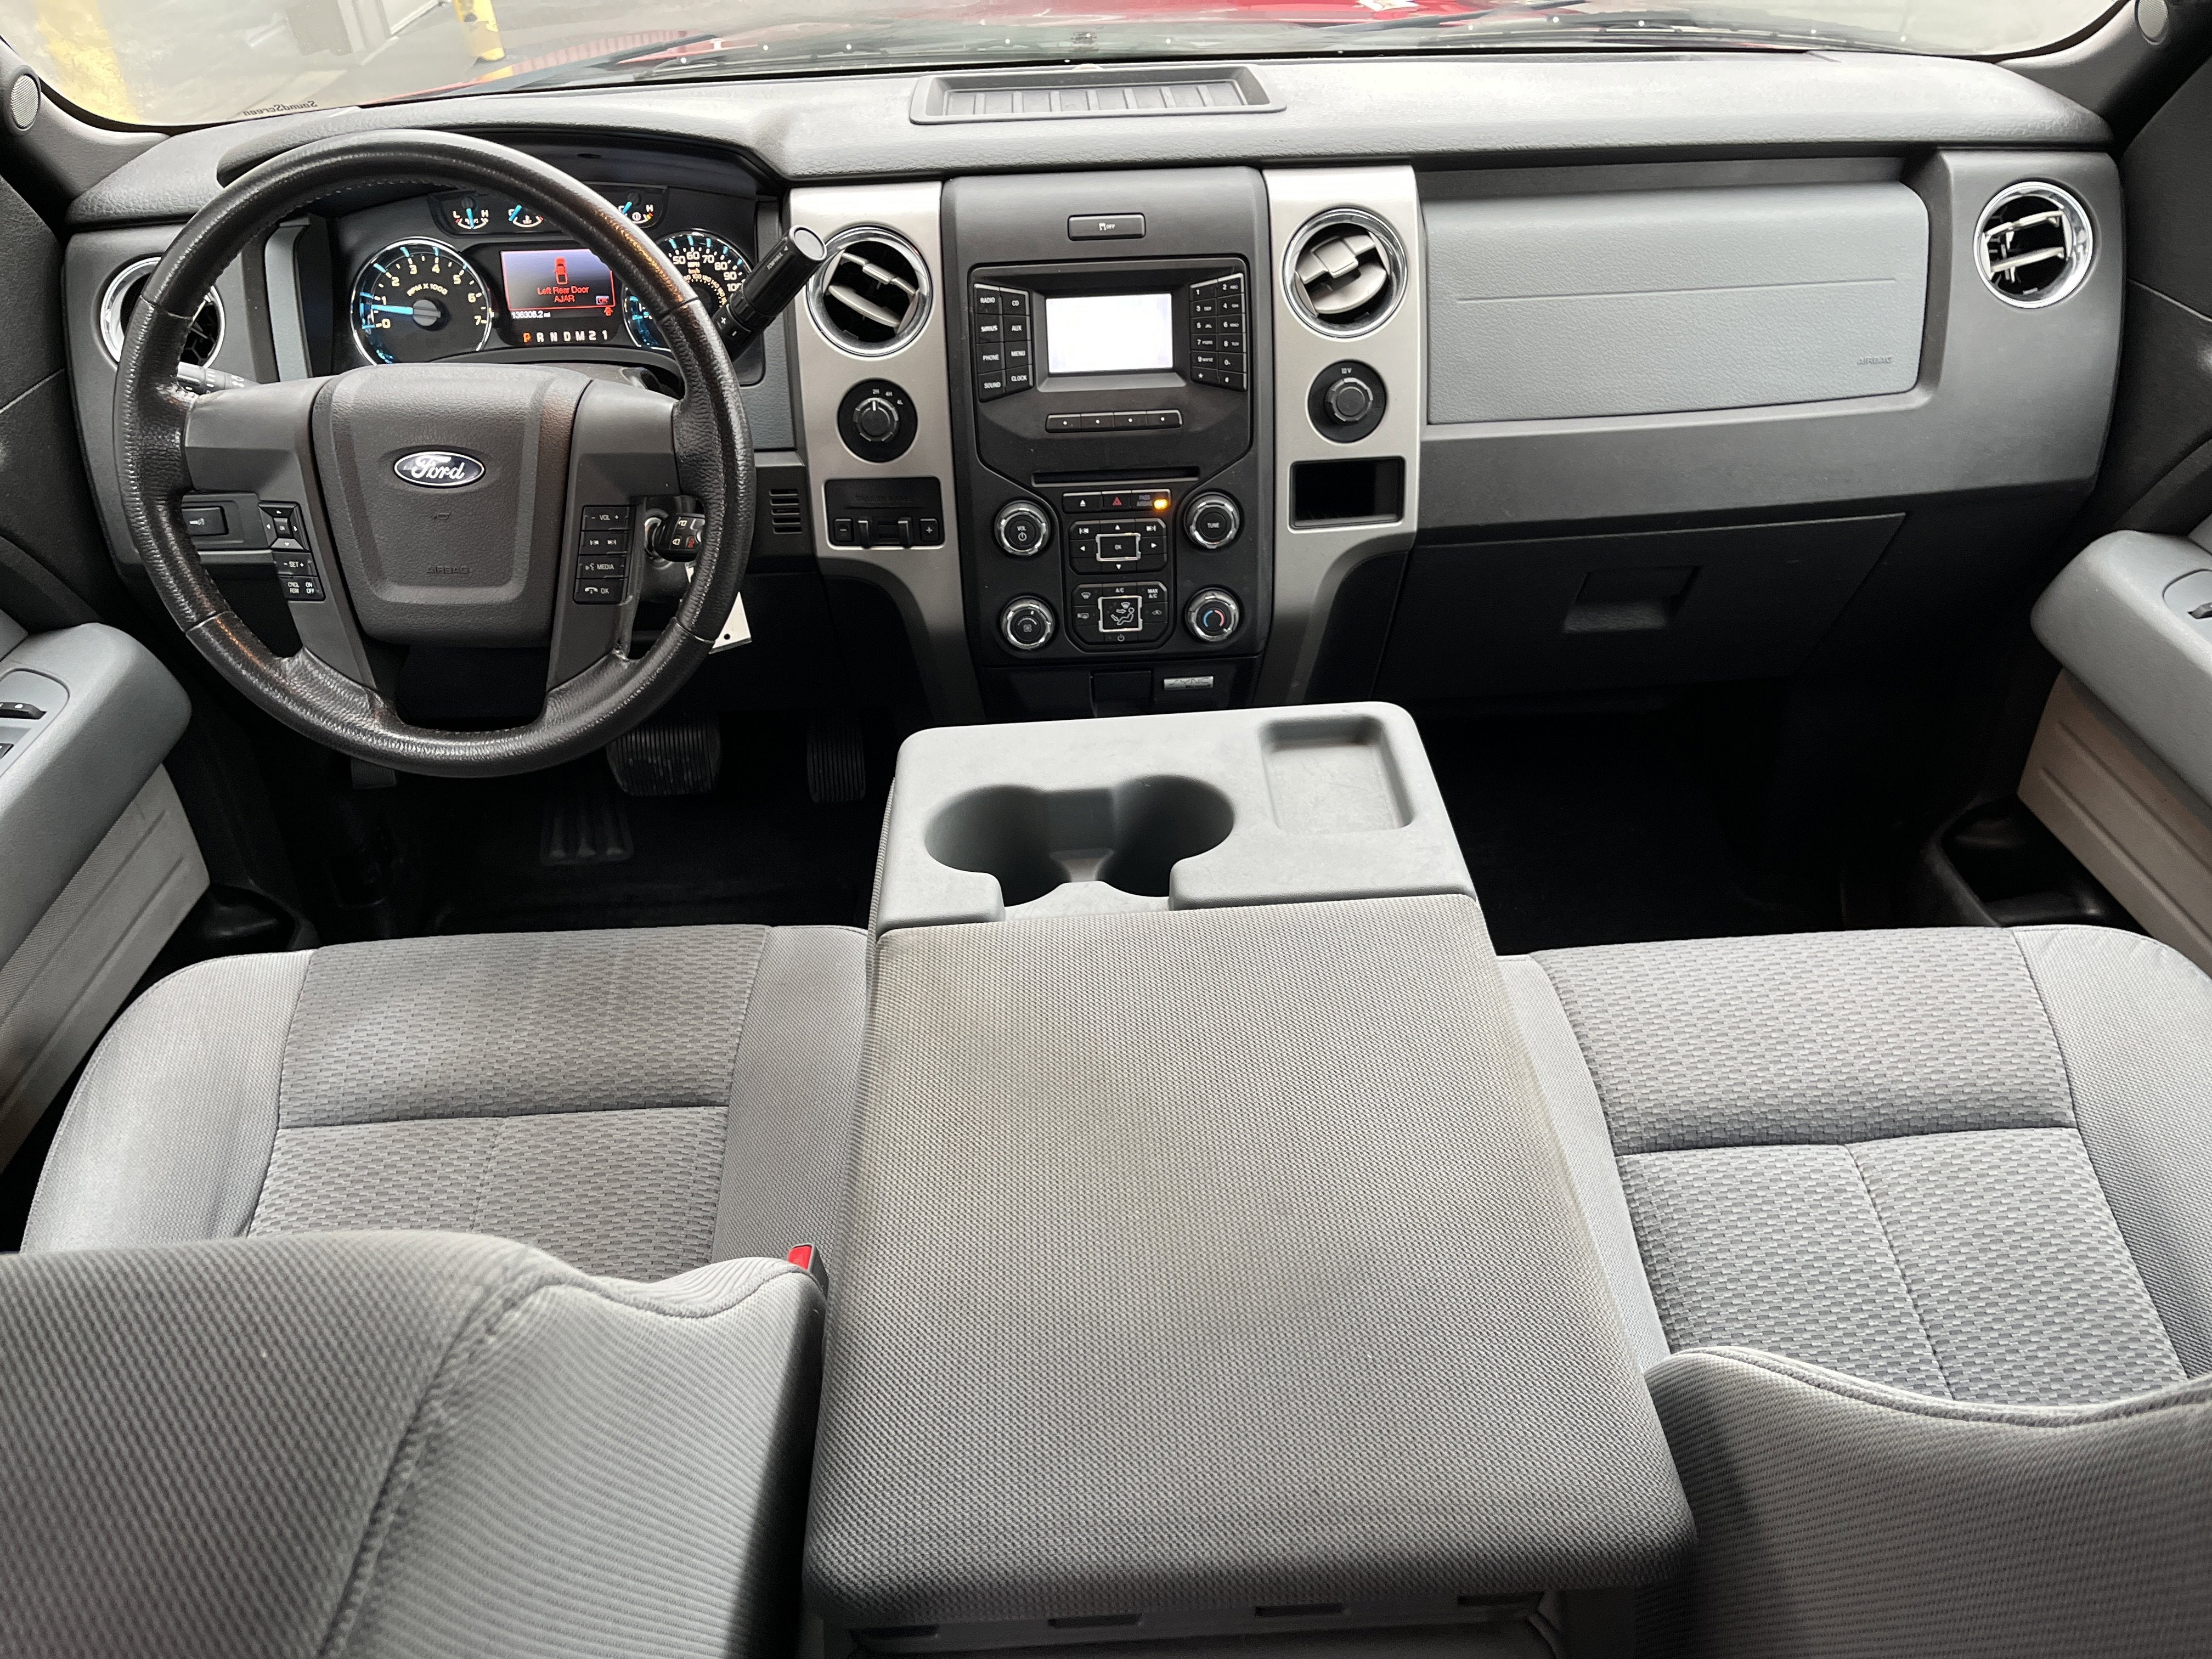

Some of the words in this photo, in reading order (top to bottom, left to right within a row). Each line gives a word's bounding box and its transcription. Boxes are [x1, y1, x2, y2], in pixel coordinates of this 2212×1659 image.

[673, 256, 686, 265] 50
[686, 251, 700, 260] 60
[702, 255, 715, 263] 70
[409, 264, 417, 274] 3
[432, 264, 440, 273] 4
[714, 262, 727, 270] 80
[392, 276, 400, 286] 2
[453, 274, 461, 284] 5
[723, 272, 737, 280] 90
[430, 283, 448, 295] 1000
[537, 286, 552, 295] Left
[571, 285, 590, 294] Door
[381, 296, 387, 305] 1
[468, 293, 476, 302] 6
[382, 318, 391, 328] 0
[474, 315, 481, 325] 7
[523, 332, 531, 343] P
[537, 332, 544, 342] R
[550, 332, 558, 342] N
[563, 331, 571, 342] D
[575, 330, 585, 341] M
[589, 330, 596, 341] 2
[602, 330, 607, 340] 1
[411, 455, 465, 479] Ford
